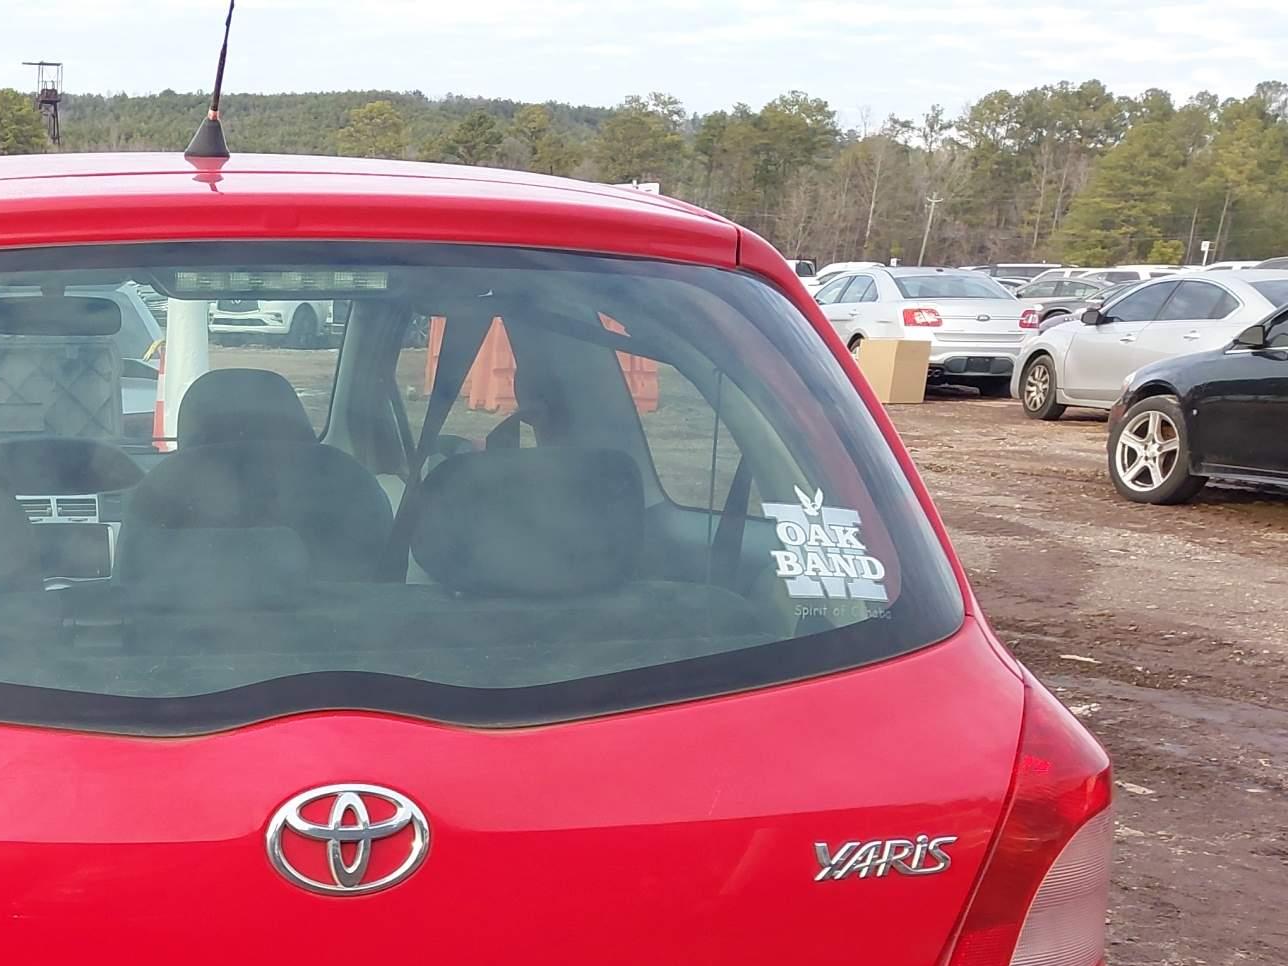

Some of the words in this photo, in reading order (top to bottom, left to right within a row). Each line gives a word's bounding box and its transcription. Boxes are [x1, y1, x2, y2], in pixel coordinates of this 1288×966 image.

[776, 521, 866, 549] OAK
[770, 551, 885, 580] BAND
[794, 603, 827, 619] Spirit
